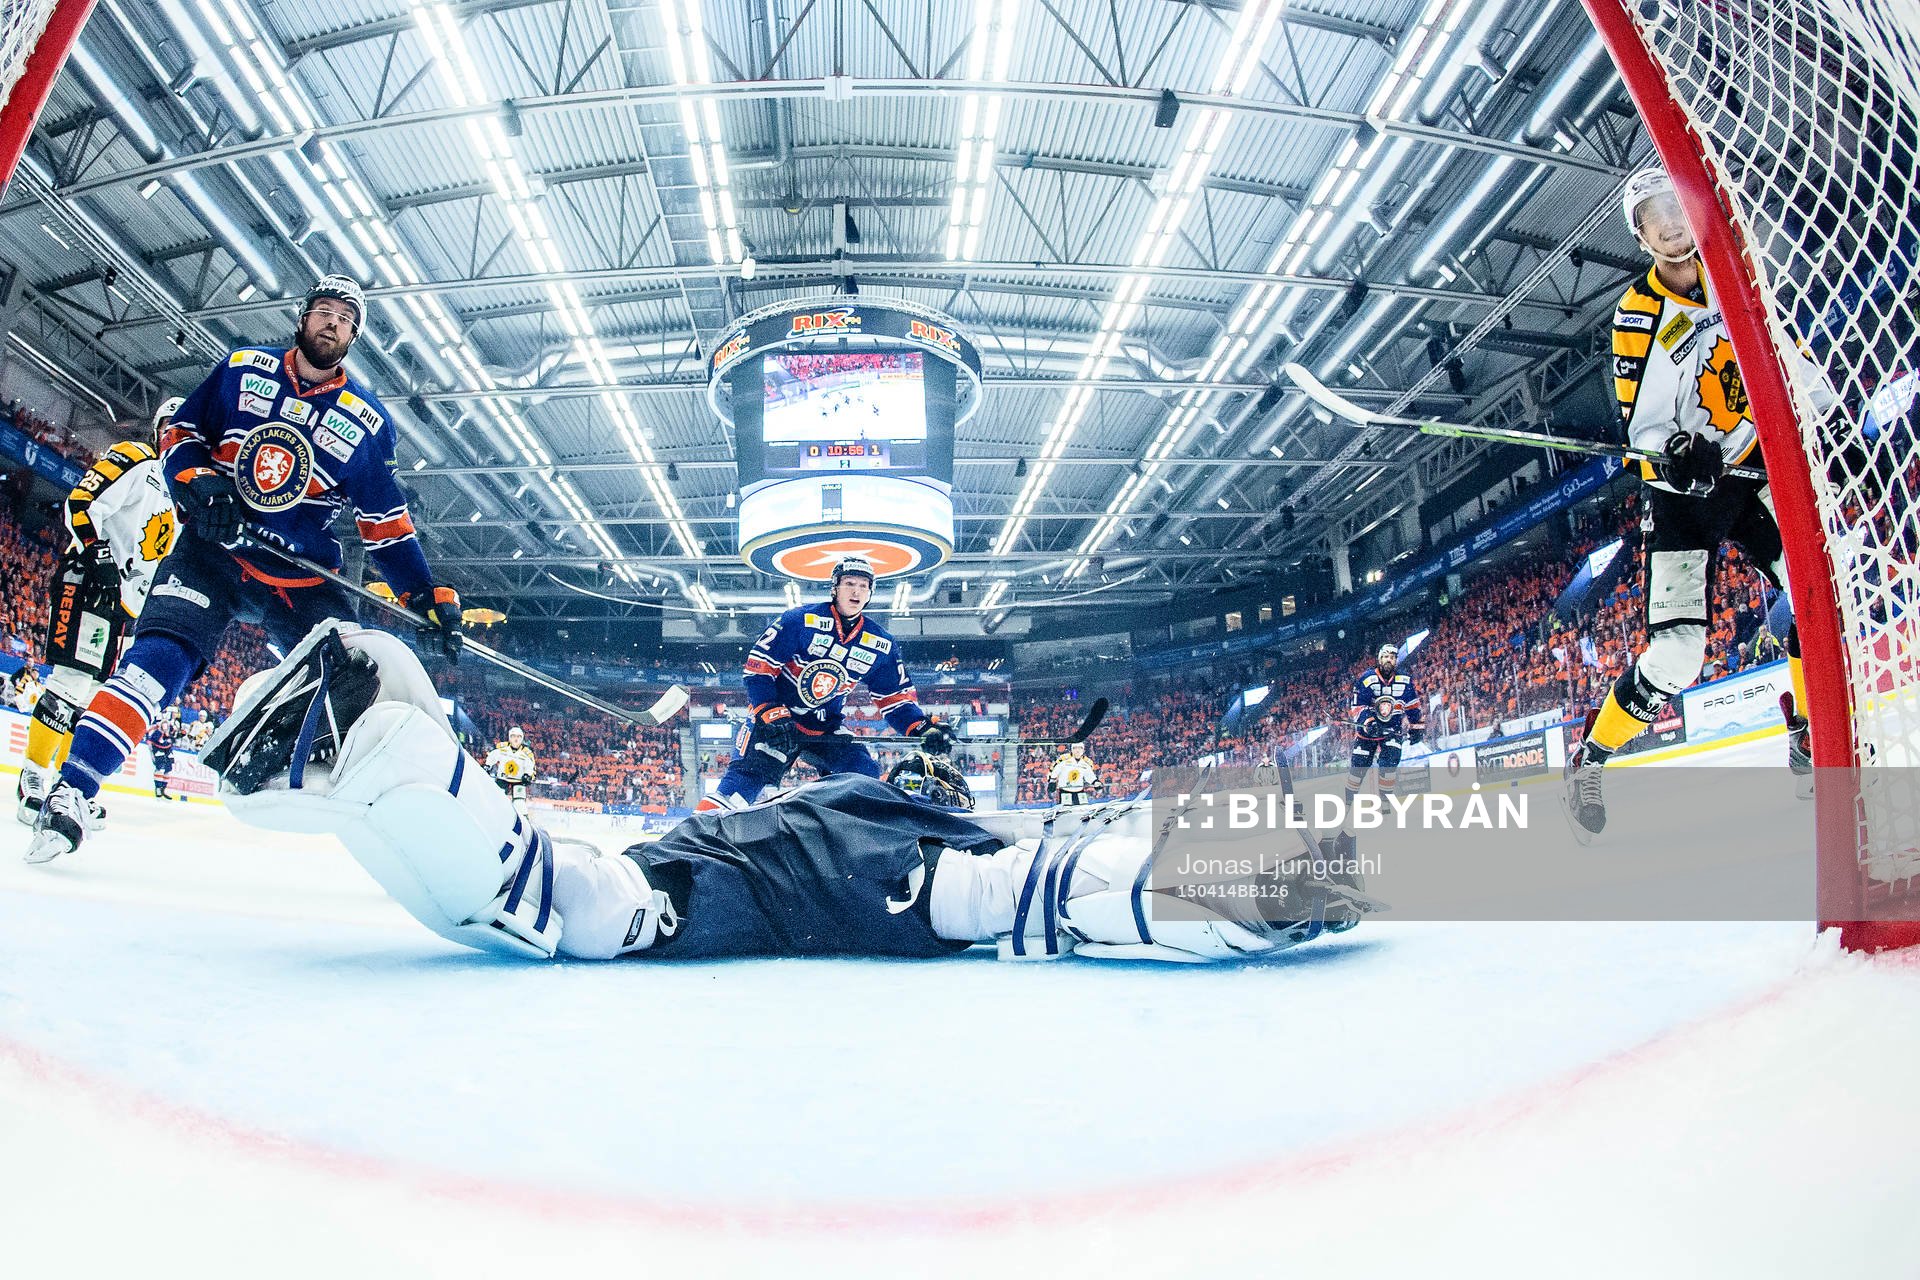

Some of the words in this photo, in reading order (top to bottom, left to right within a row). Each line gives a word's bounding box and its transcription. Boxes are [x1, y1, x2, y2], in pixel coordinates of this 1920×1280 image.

[793, 312, 846, 331] RIX
[1620, 316, 1644, 326] SPORT
[911, 320, 953, 347] RIX
[252, 354, 274, 369] put
[714, 337, 740, 368] RIX
[245, 378, 273, 396] wilo
[314, 383, 336, 395] CCM
[359, 407, 379, 429] put
[326, 415, 358, 441] wilo
[262, 428, 297, 445] LAKERS
[294, 443, 308, 484] HOCKEY
[809, 445, 819, 456] 0
[870, 444, 880, 456] 1
[78, 469, 105, 492] 25
[260, 491, 295, 505] HJÄRTA
[54, 584, 77, 649] REPAY
[875, 640, 889, 651] put
[852, 649, 873, 662] wilo
[1703, 694, 1736, 710] PRO
[1742, 682, 1776, 700] SPA
[1625, 700, 1658, 721] NORR
